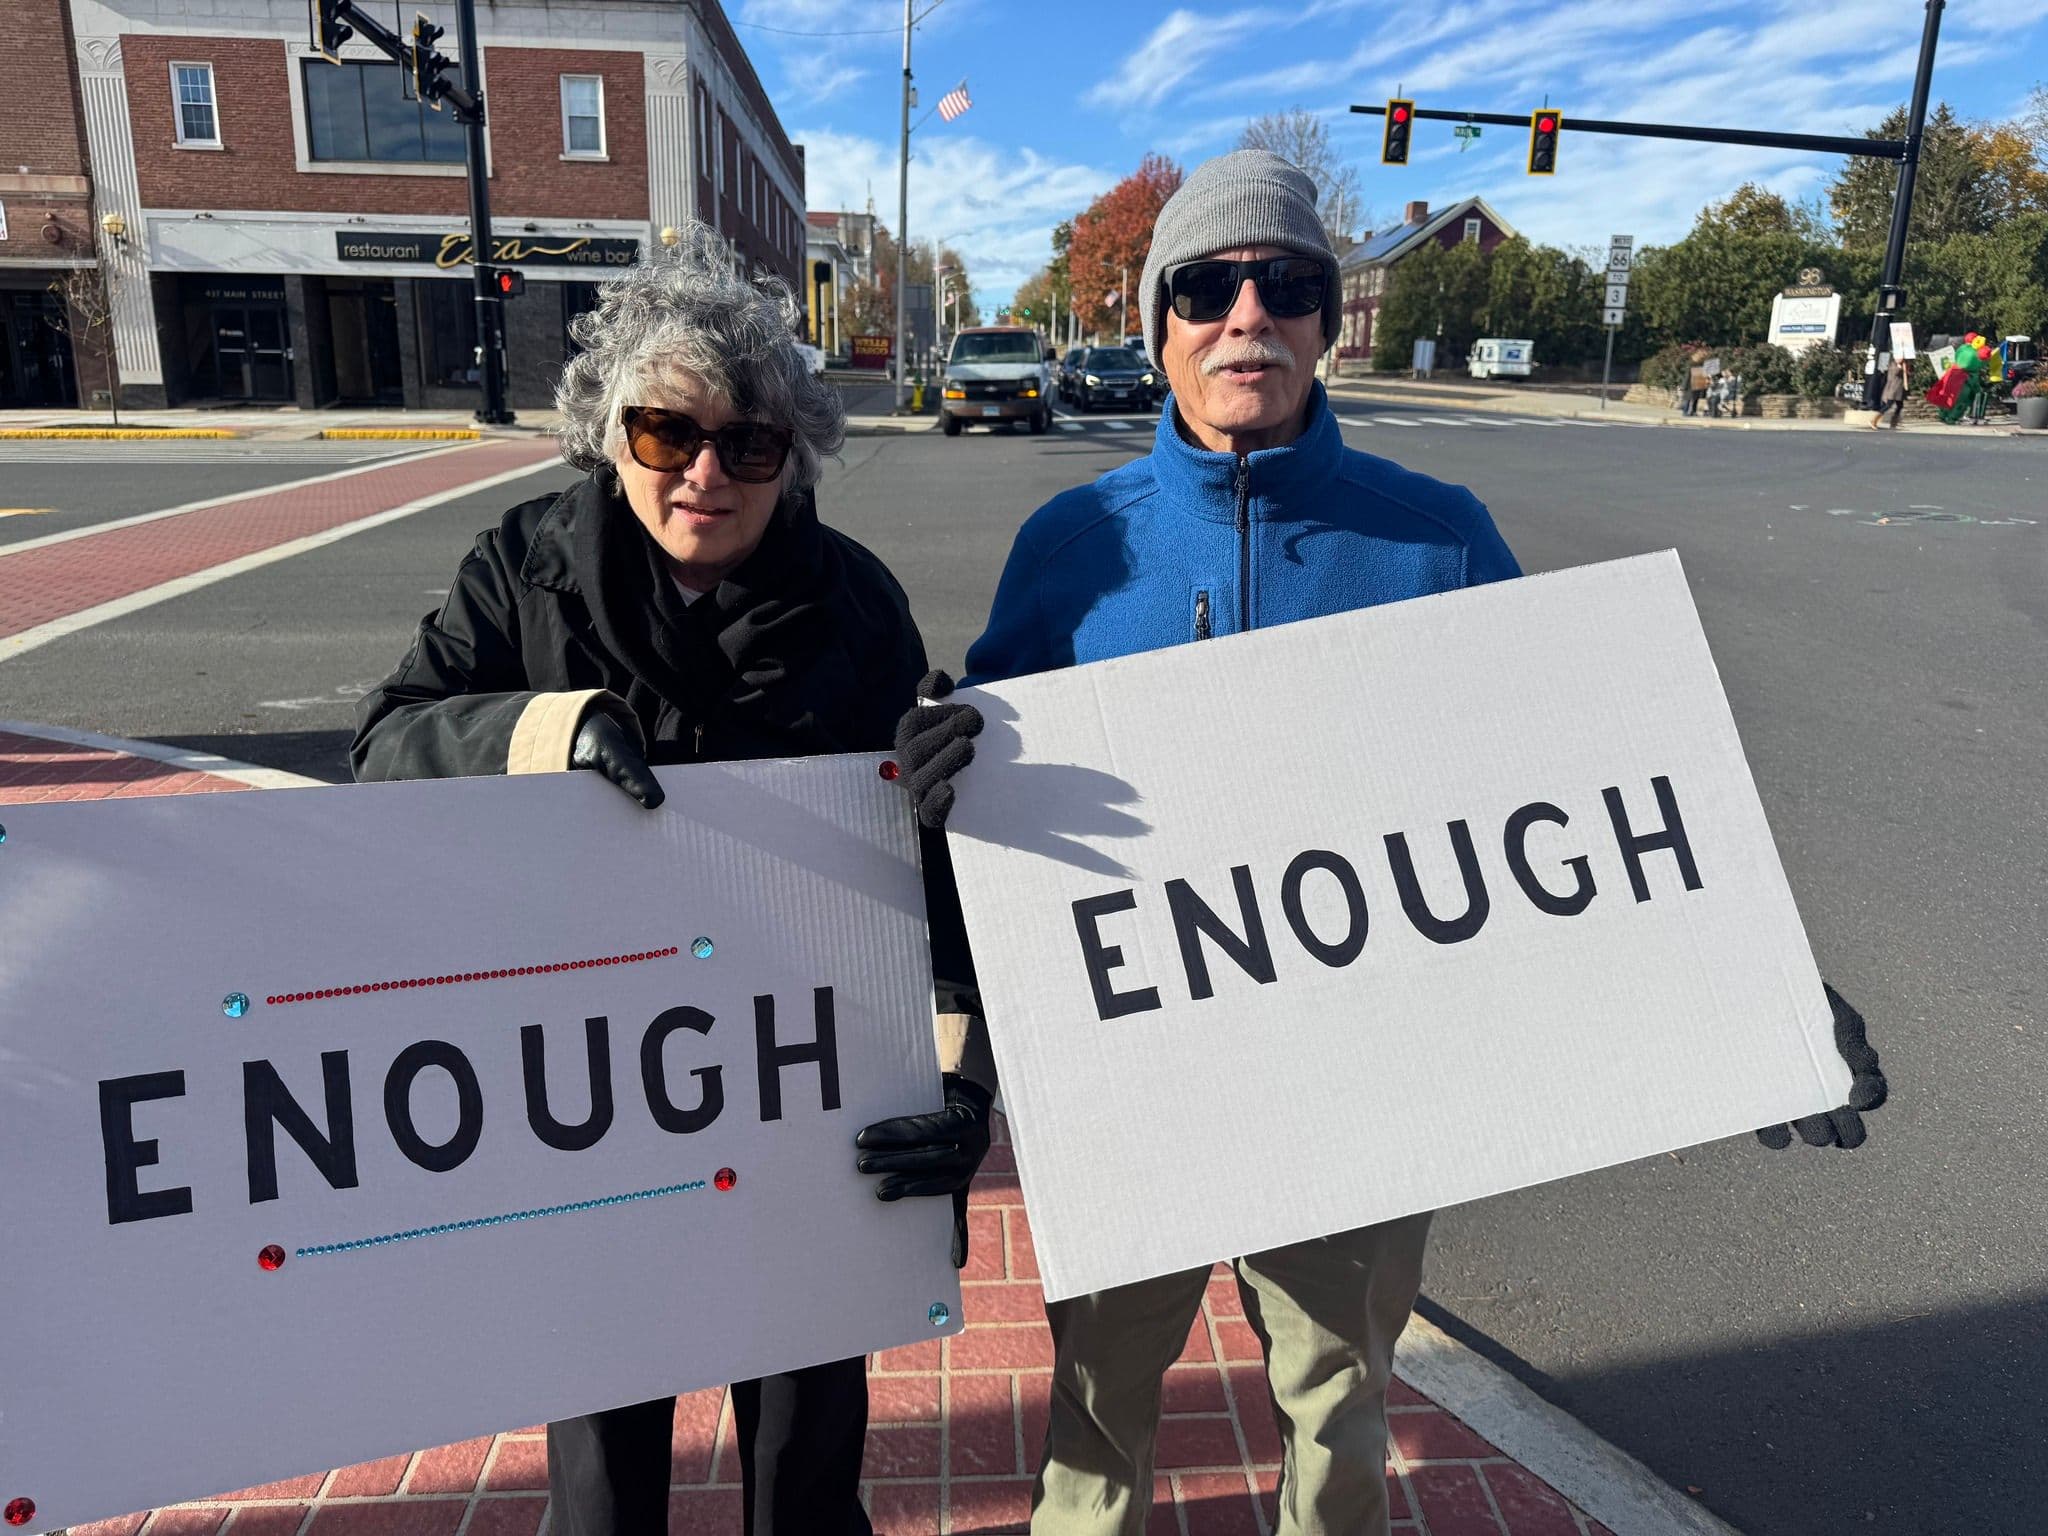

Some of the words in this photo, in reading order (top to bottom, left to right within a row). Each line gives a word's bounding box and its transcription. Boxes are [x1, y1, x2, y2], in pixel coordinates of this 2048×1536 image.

[343, 241, 420, 259] restaurant
[566, 248, 601, 264] wine
[605, 248, 631, 264] bar
[1612, 253, 1627, 267] 66
[1800, 267, 1821, 286] 96
[223, 289, 247, 299] MAIN
[251, 290, 287, 300] STREET
[1611, 289, 1620, 303] 3
[1783, 286, 1833, 297] WASHINGTON
[1072, 776, 1704, 1020] ENOUGH
[99, 986, 841, 1225] ENOUGH
